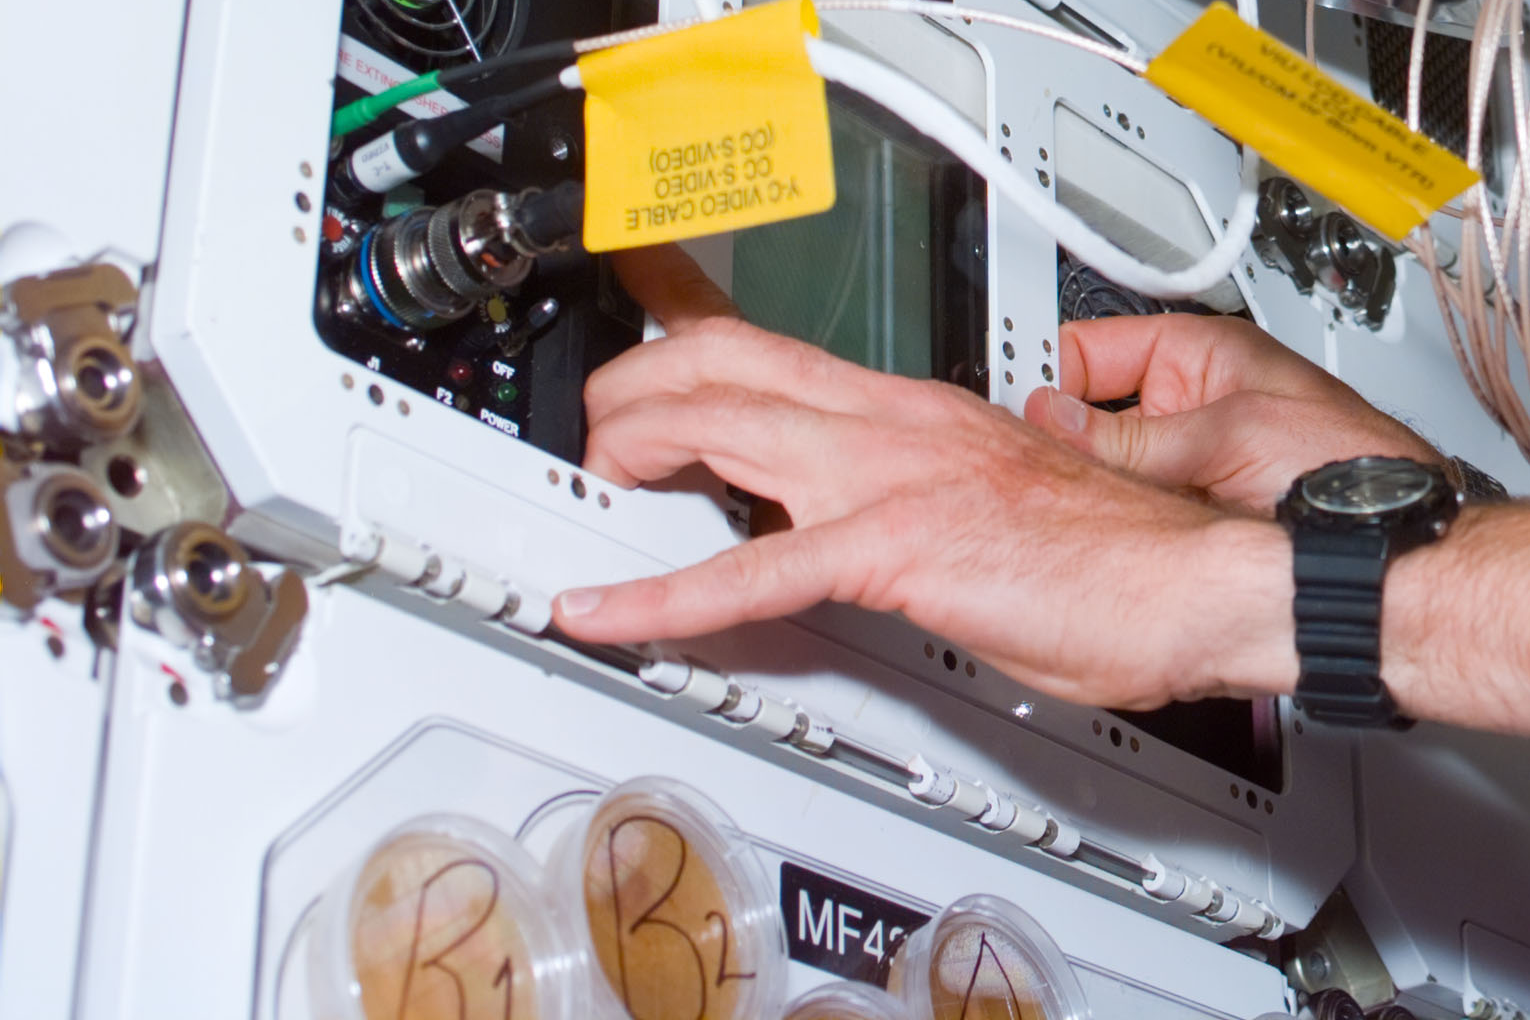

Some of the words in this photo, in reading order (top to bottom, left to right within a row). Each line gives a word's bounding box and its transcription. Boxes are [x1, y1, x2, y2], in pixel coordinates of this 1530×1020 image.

[740, 119, 774, 153] (CC
[1353, 103, 1427, 155] CABLE
[650, 136, 734, 173] S-VIDEO)
[742, 155, 772, 180] CC
[654, 164, 735, 199] S-VIDEO
[768, 176, 801, 203] Y-C
[626, 199, 695, 230] CABLE
[701, 186, 763, 216] VIDEO
[492, 361, 515, 380] OFF
[436, 387, 453, 405] F2
[480, 409, 520, 436] POWER
